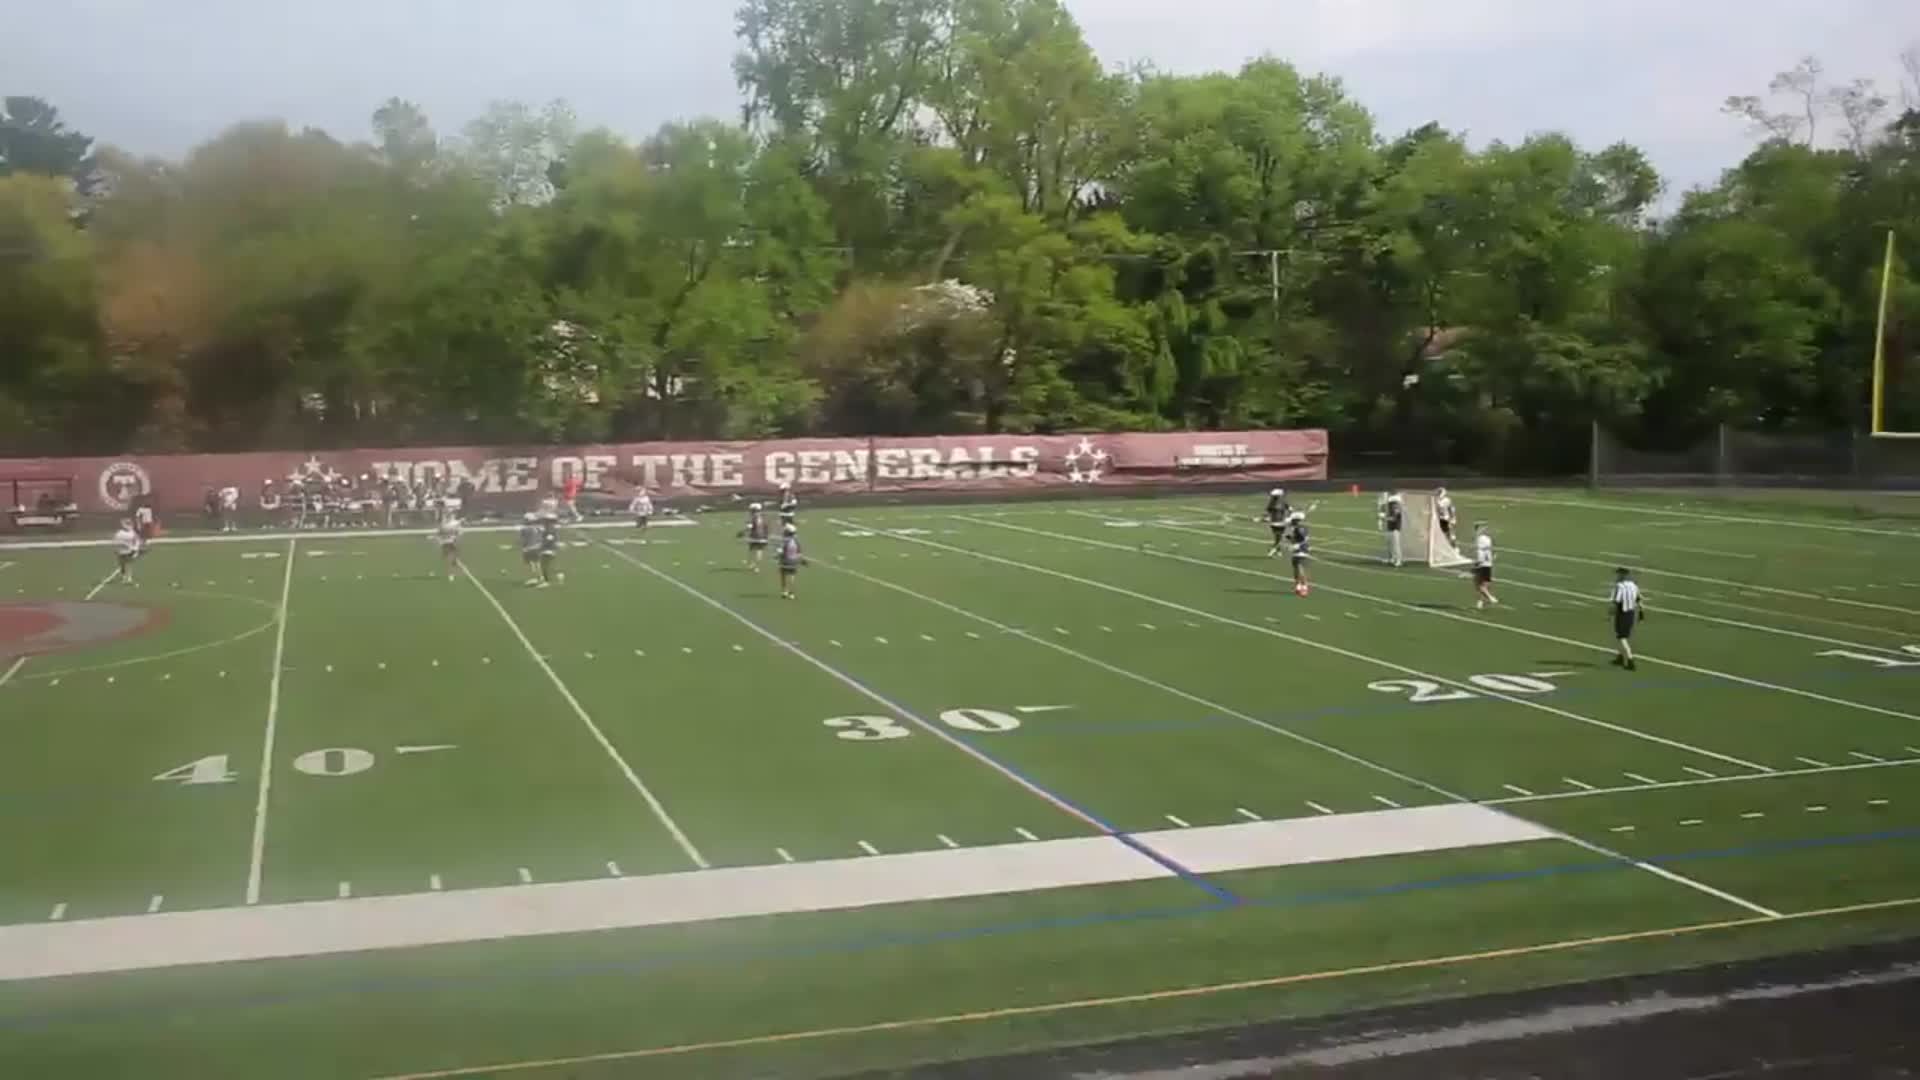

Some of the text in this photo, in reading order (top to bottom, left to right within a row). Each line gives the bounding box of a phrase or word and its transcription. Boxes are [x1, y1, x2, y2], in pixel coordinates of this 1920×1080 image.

[372, 446, 1039, 493] HOME OF THE GENERALS
[1367, 674, 1556, 702] 20
[823, 708, 1021, 740] 30
[152, 748, 375, 785] 40
